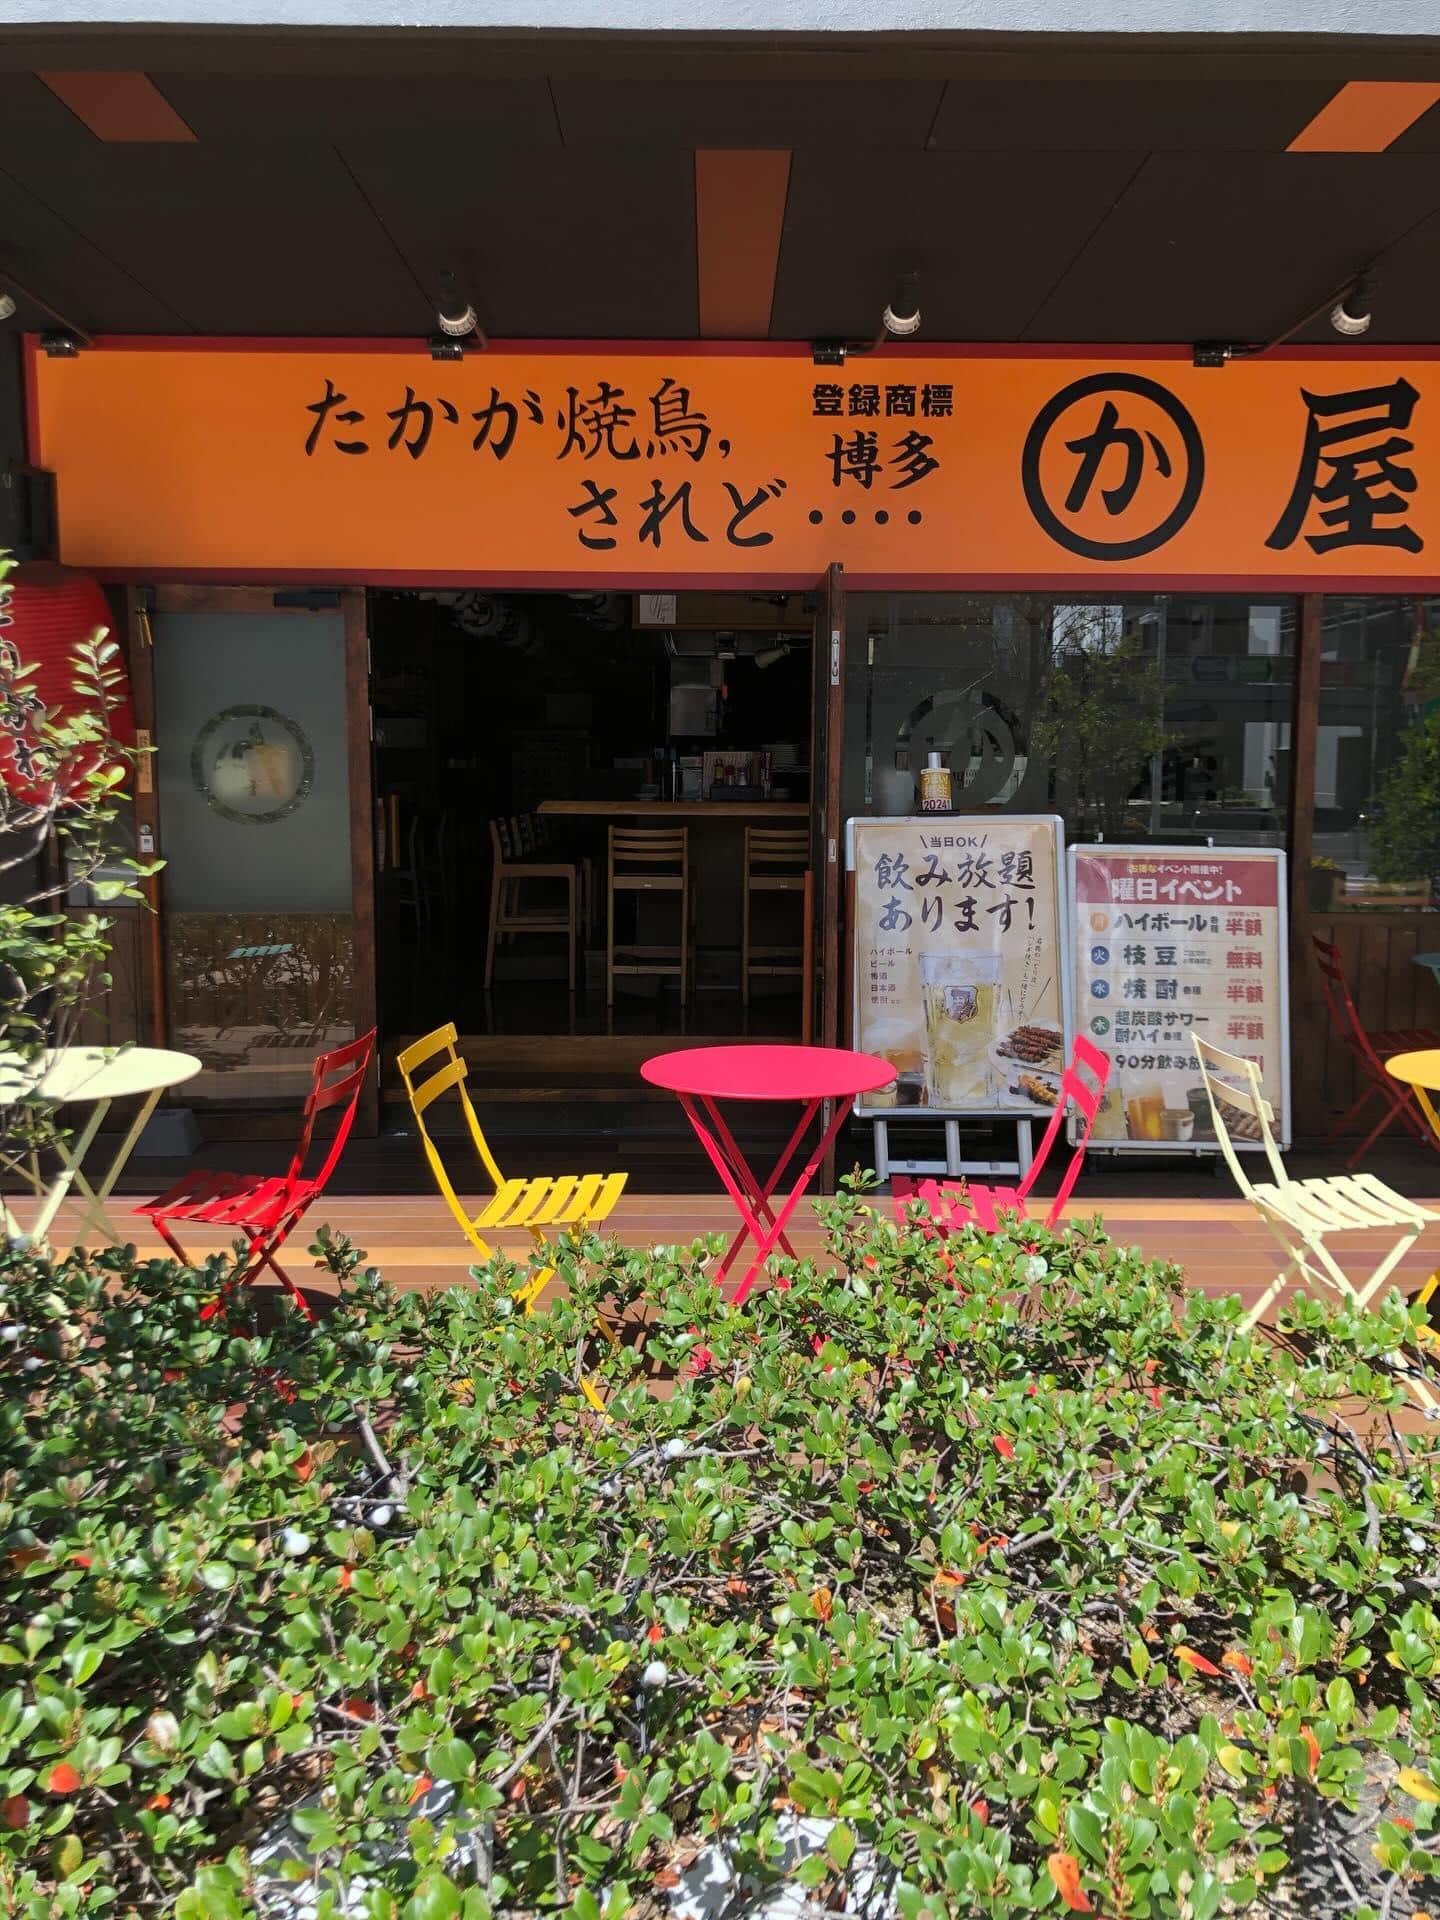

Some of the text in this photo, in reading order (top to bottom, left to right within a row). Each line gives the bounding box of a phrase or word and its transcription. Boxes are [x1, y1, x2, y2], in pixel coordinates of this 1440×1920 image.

[812, 384, 954, 418] 登録商標
[825, 430, 941, 490] 博多
[930, 836, 979, 848] 当日OK
[874, 851, 1036, 890] 飲み放題
[1111, 878, 1242, 902] 曜日イベント
[878, 894, 1035, 933] あります!
[1114, 912, 1207, 931] ハイボール
[1226, 917, 1263, 936] 半額
[1123, 944, 1178, 966] 枝豆
[1226, 951, 1263, 969] 無料
[1123, 978, 1179, 999] 焼酎
[1227, 985, 1264, 1003] 半額
[1227, 1022, 1264, 1040] 半額
